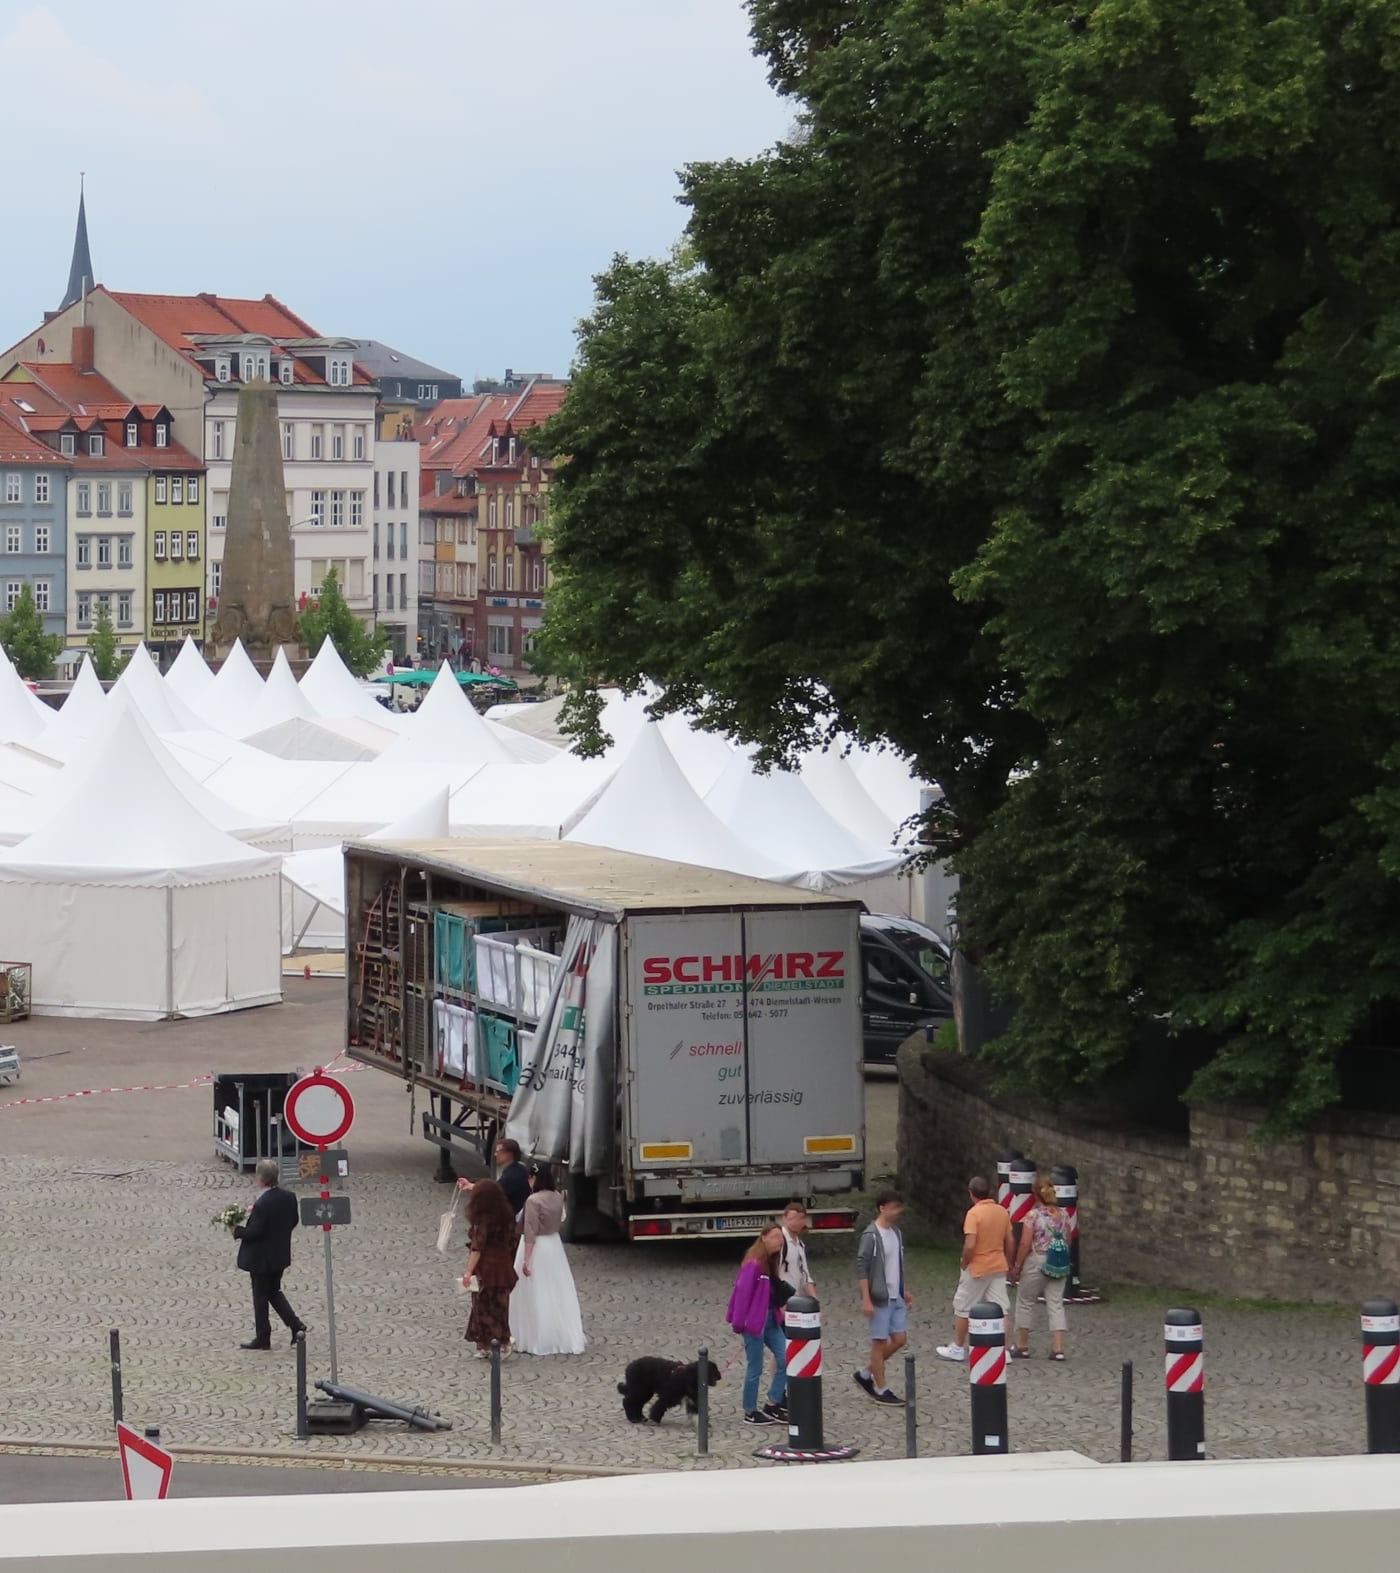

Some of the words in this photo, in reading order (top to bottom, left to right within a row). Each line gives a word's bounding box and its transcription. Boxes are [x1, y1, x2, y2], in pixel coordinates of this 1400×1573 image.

[643, 951, 845, 984] SCHWARZ
[647, 984, 744, 995] SPEDITION
[763, 980, 841, 991] DIEMELSTADT
[689, 1000, 714, 1010] Straße
[716, 999, 727, 1008] 27
[702, 1012, 732, 1021] Telefon:
[769, 1008, 788, 1018] 5077
[688, 1041, 743, 1057] schnell
[717, 1064, 743, 1081] gut
[718, 1089, 804, 1106] zuverlässig
